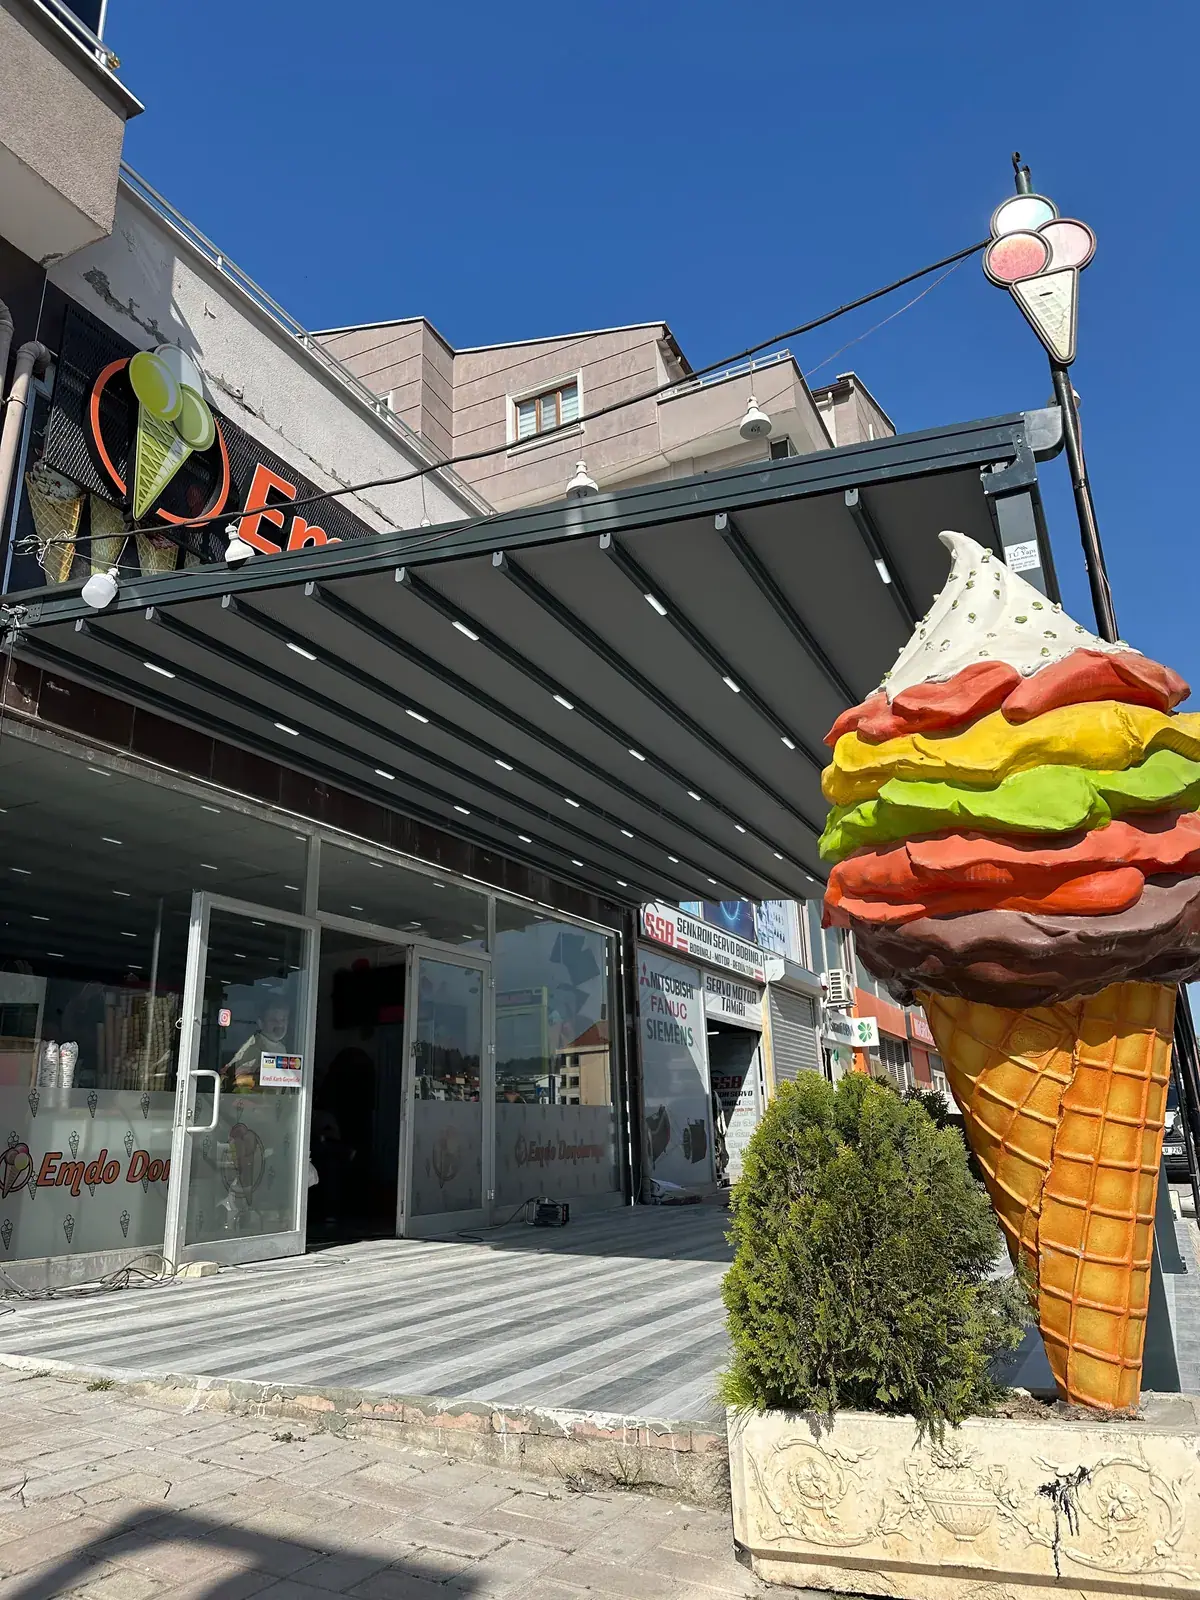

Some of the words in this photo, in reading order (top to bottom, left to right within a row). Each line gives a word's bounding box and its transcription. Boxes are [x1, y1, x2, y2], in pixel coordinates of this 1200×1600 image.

[645, 912, 675, 947] SSB
[677, 917, 713, 946] SENKRON
[713, 934, 735, 955] SERVO
[714, 953, 730, 966] MOTOR
[650, 971, 694, 1000] MITSUBISHI
[706, 976, 731, 997] SERVO
[731, 984, 757, 1005] MOTOR
[650, 995, 688, 1020] FANUC
[646, 1017, 694, 1047] SIEMENS
[36, 1148, 121, 1197] Emdo
